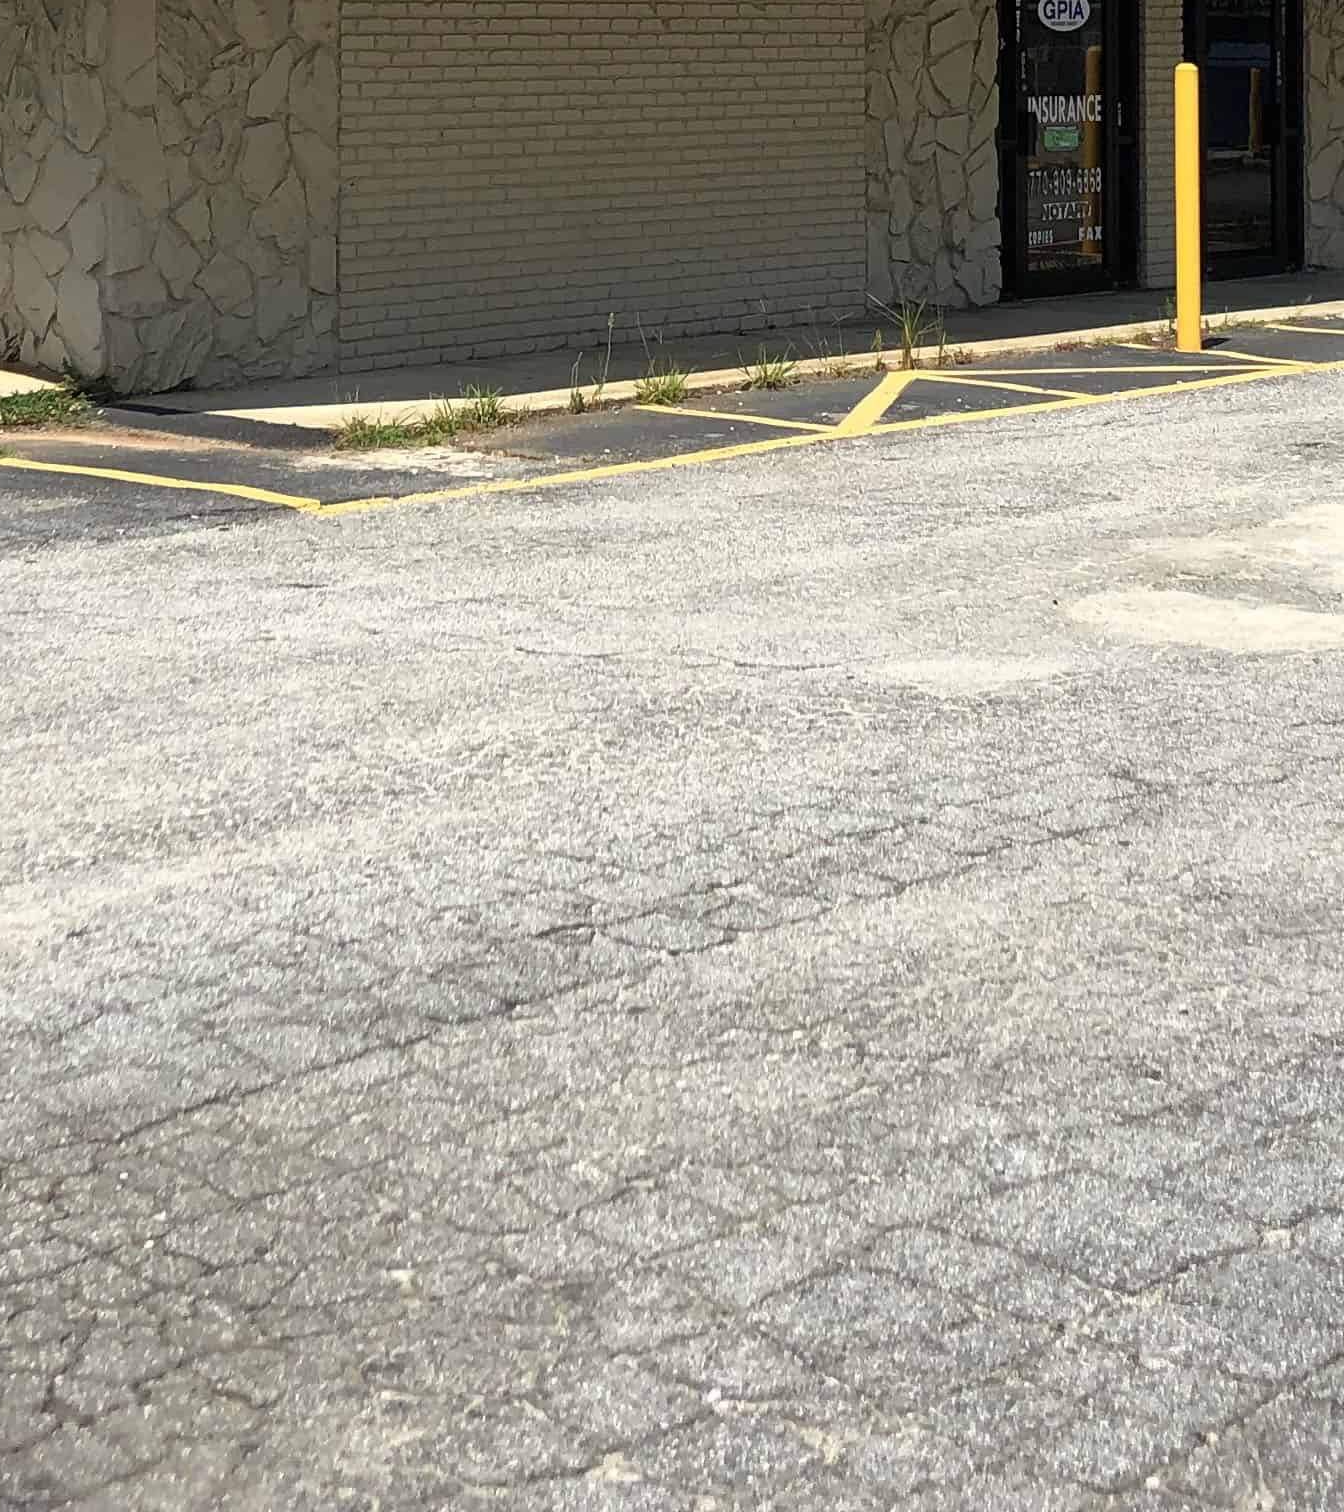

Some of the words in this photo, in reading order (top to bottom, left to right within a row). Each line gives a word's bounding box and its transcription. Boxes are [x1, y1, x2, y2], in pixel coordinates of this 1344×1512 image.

[1043, 0, 1084, 21] GPIA
[1027, 95, 1102, 124] INSURANCE
[1028, 230, 1054, 246] COPIES
[1078, 226, 1103, 241] FAX
